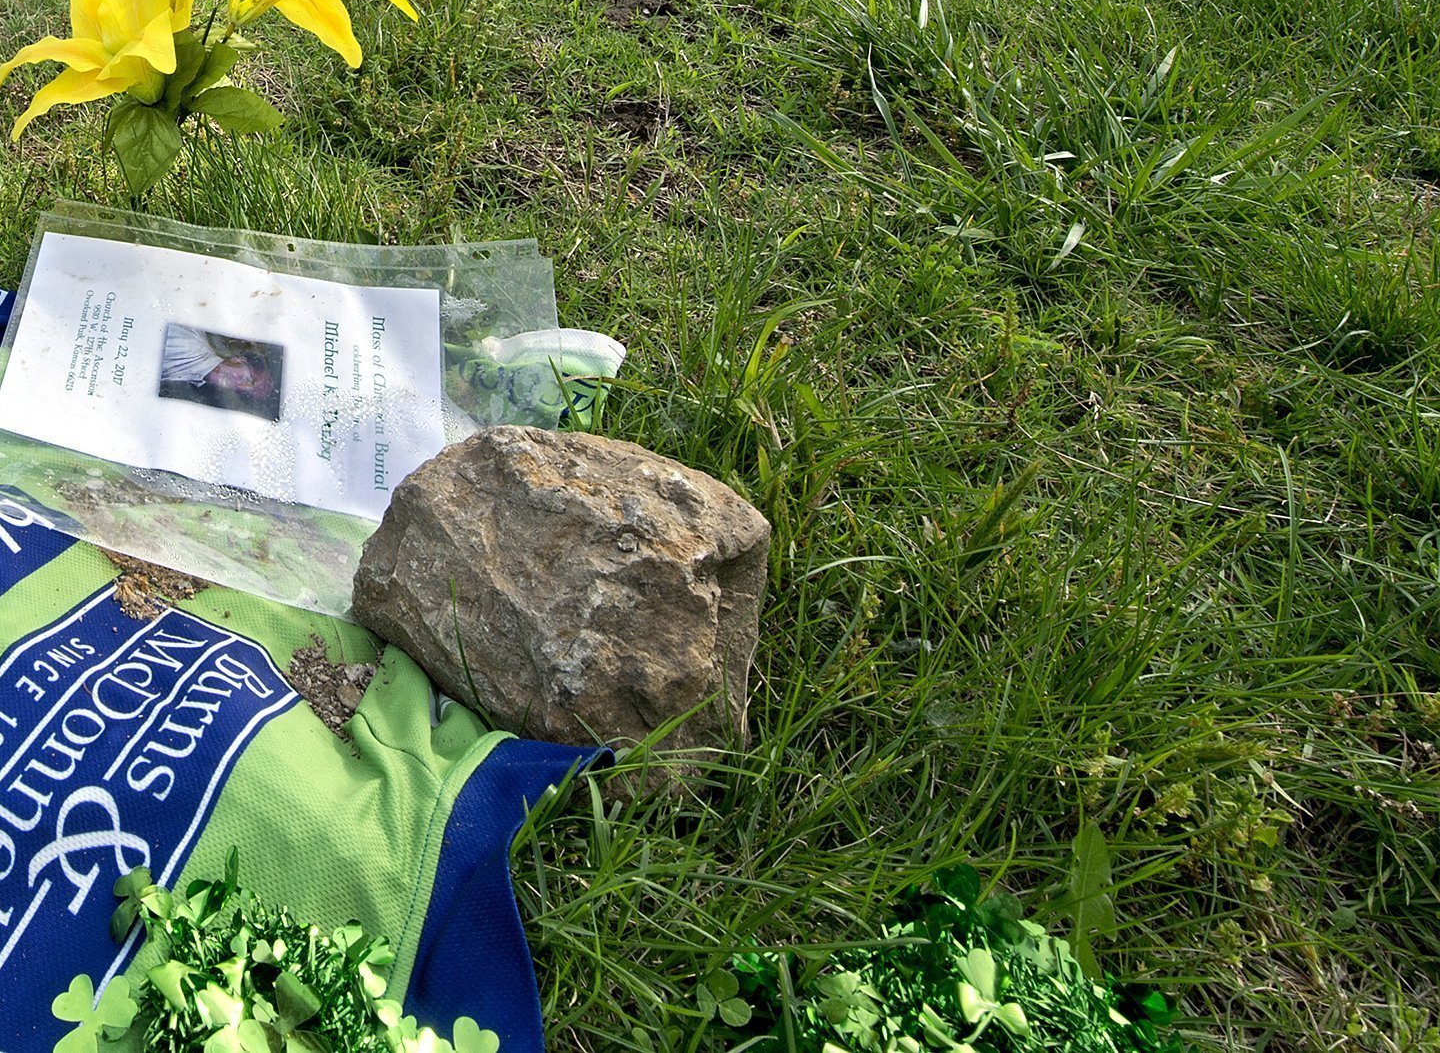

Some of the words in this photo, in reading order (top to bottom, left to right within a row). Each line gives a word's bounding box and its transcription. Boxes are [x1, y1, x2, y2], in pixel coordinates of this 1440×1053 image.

[80, 290, 94, 322] Overland
[92, 304, 101, 320] 9510
[103, 291, 116, 322] Church
[75, 324, 87, 341] Park,
[88, 322, 98, 333] W.
[101, 324, 109, 333] of
[118, 317, 135, 342] May
[372, 315, 386, 350] Mass
[84, 336, 95, 355] 127th
[97, 336, 107, 351] the
[114, 345, 129, 360] 22,
[323, 320, 339, 379] Michael
[70, 343, 83, 370] Kansas
[79, 357, 91, 379] Street
[352, 345, 362, 391] celebrating
[373, 355, 385, 369] of
[65, 371, 76, 391] 66213
[87, 354, 104, 396] Ascension
[112, 363, 126, 386] 2017
[373, 372, 387, 435] Chriian
[353, 432, 362, 442] of
[374, 442, 390, 491] Burial
[14, 637, 96, 702] SINCE
[126, 653, 274, 801] Burns
[28, 785, 151, 916] &
